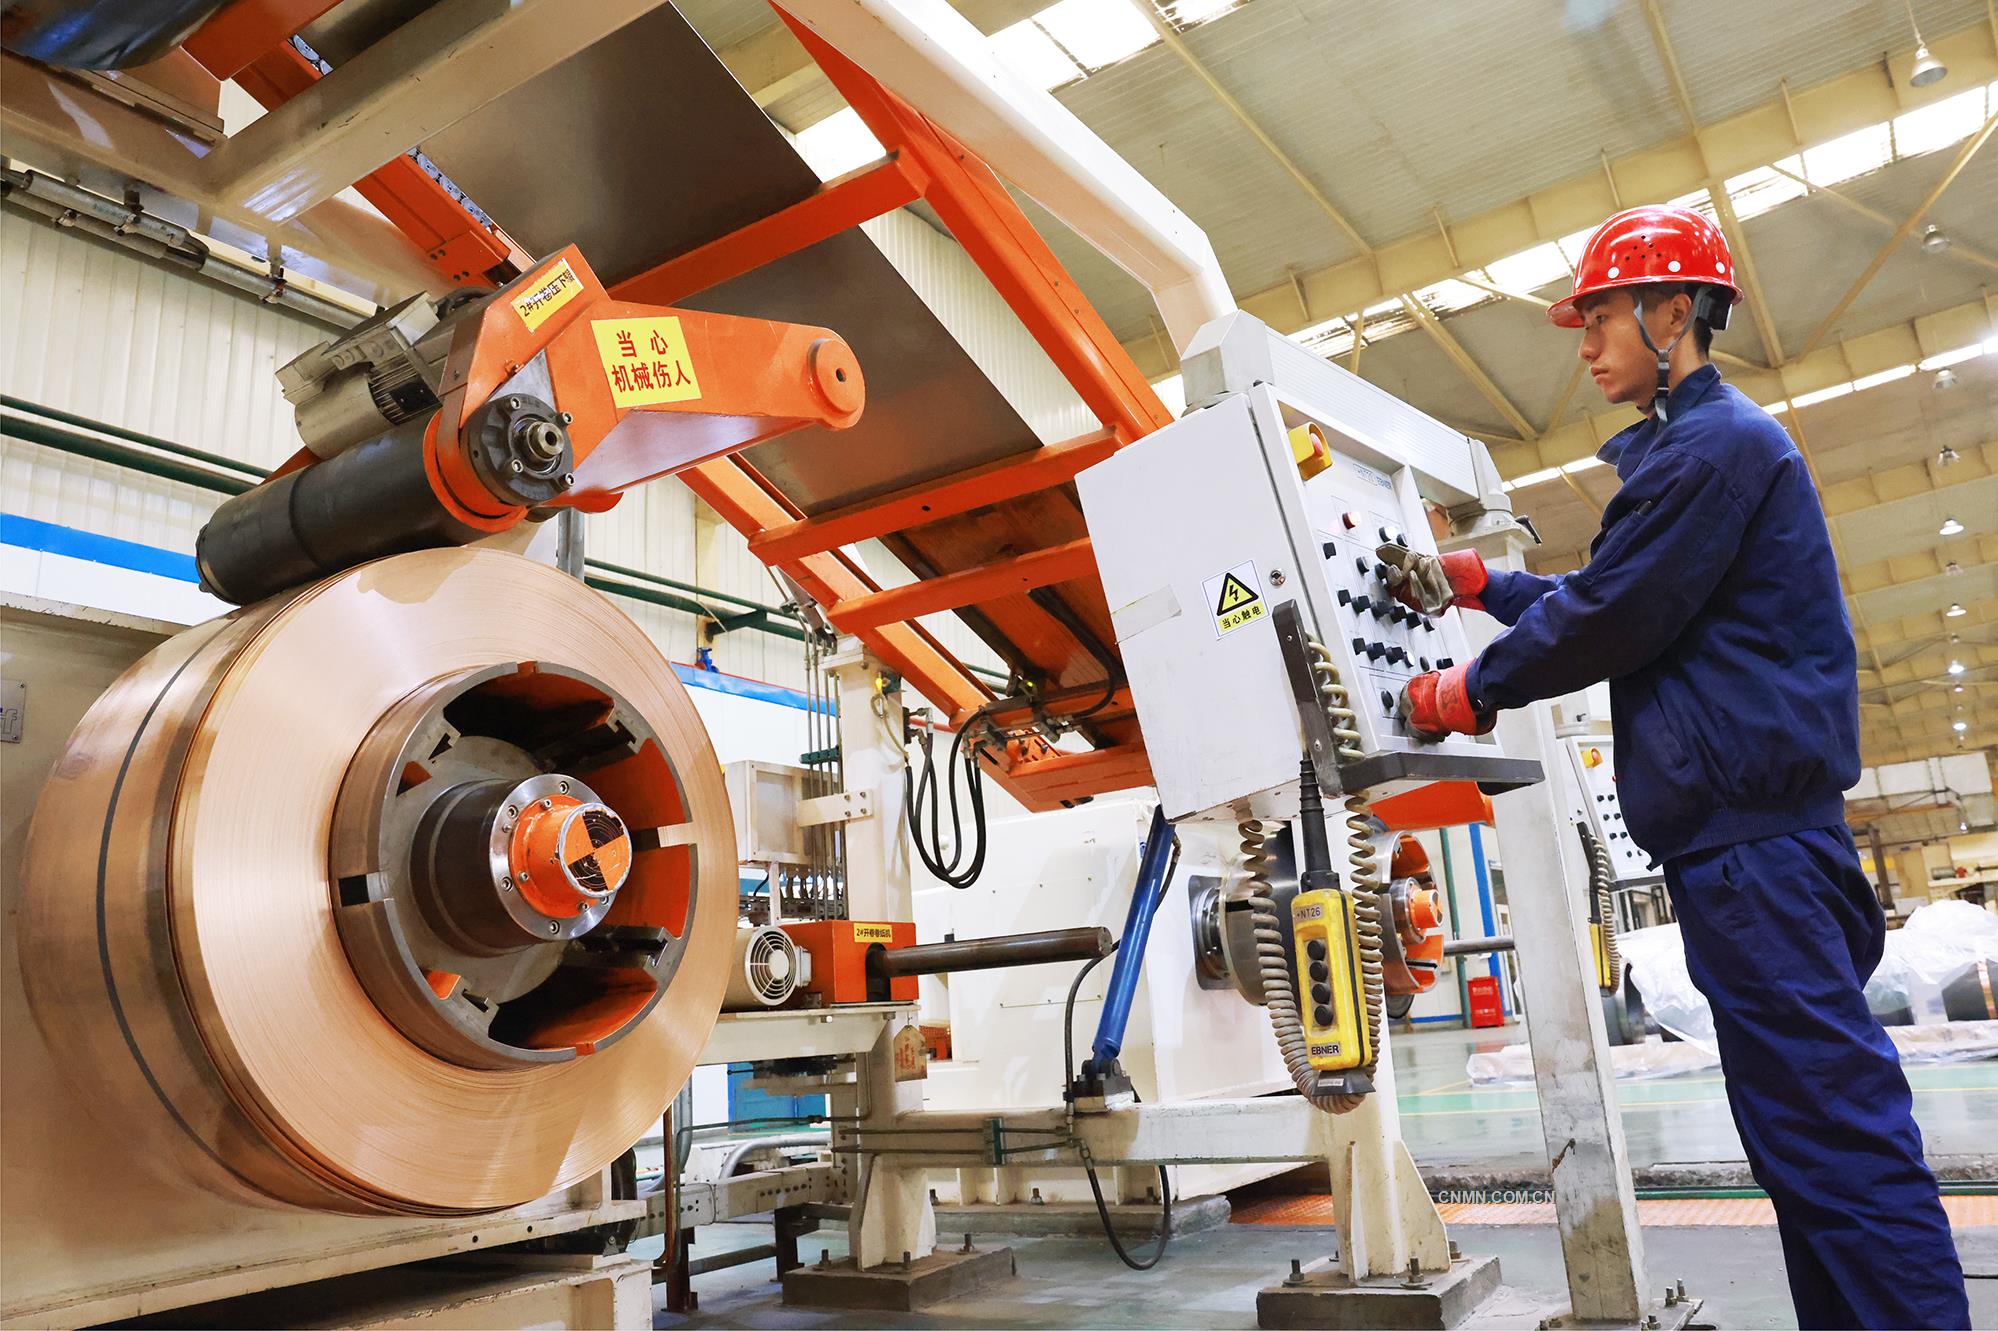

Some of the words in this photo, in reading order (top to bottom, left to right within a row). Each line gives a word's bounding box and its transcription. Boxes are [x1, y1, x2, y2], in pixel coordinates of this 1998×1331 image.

[616, 329, 668, 358] 当心
[611, 360, 691, 393] 机械伤人
[1222, 606, 1262, 629] 当心触电
[1311, 1044, 1340, 1056] EBNER
